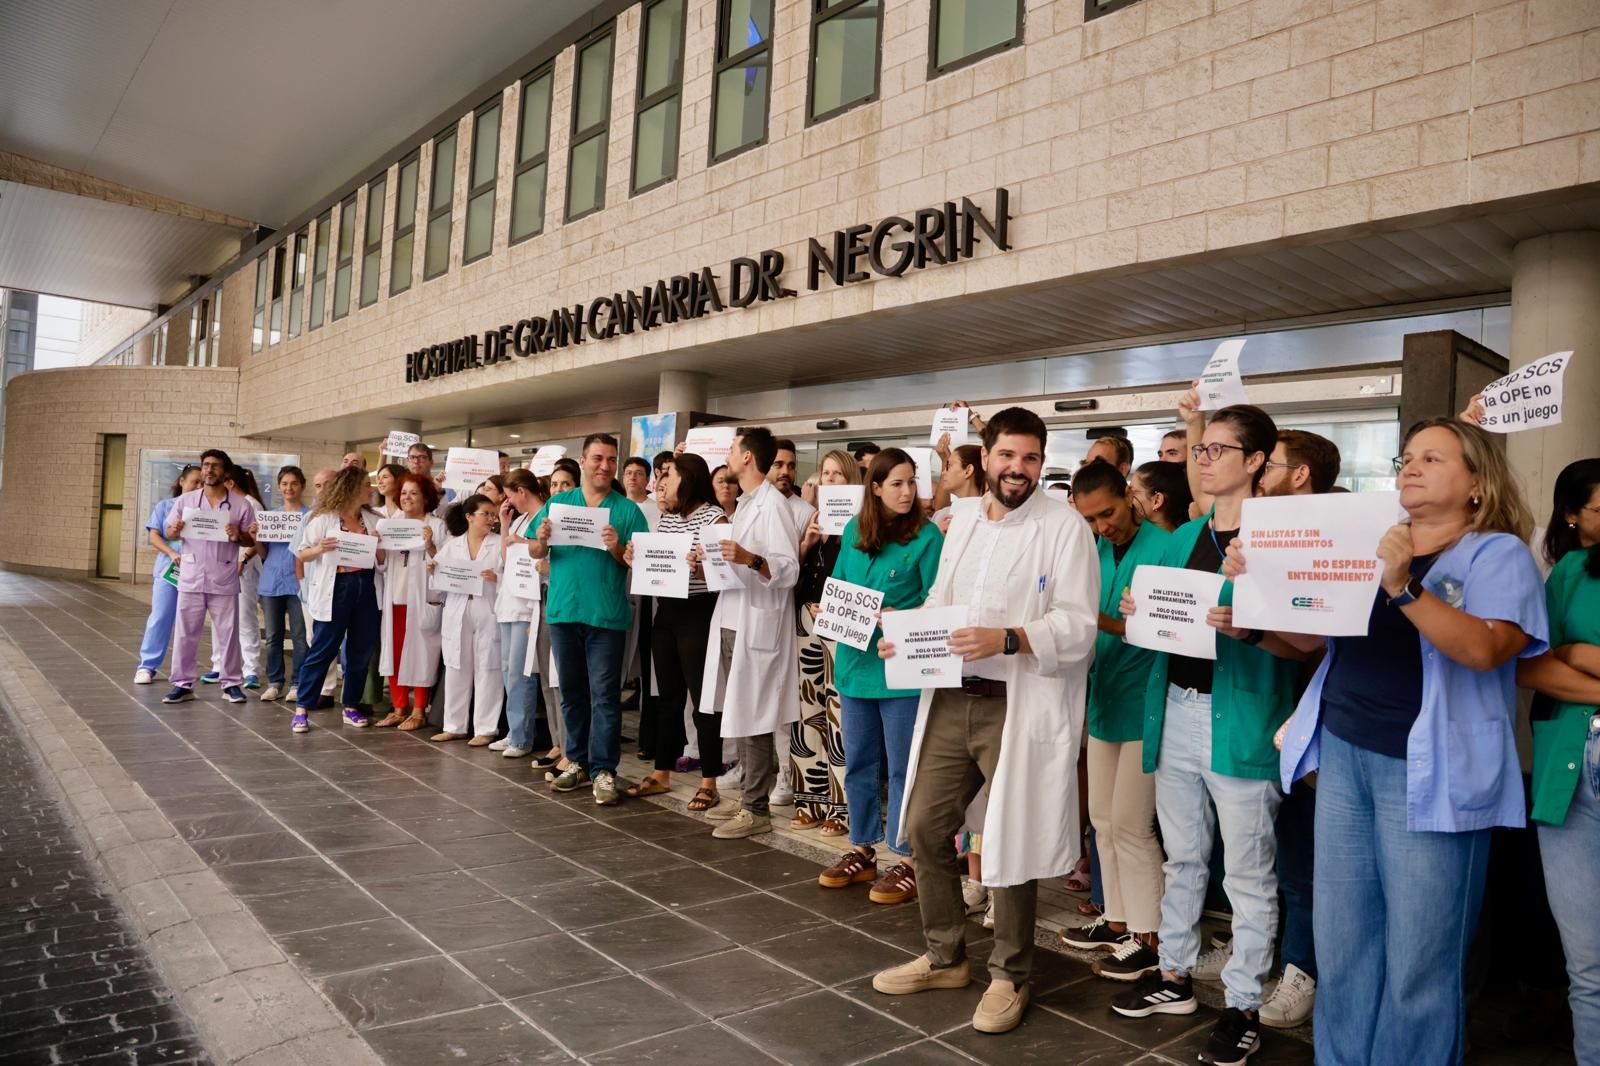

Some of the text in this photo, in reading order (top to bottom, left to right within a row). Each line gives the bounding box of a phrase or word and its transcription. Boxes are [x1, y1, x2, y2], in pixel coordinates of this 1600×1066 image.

[406, 334, 483, 383] HOSPITAL
[484, 325, 513, 365] DE
[513, 304, 584, 357] GRAN
[587, 266, 724, 340] CANARIA
[807, 187, 1010, 291] NEGRIN
[1523, 358, 1563, 379] SCS
[1484, 385, 1551, 407] la OPE no
[1480, 404, 1558, 425] es un juego
[264, 483, 271, 493] 2
[258, 513, 302, 523] Stop SCS
[1251, 529, 1320, 539] SIN LISTAS Y SIN
[1251, 540, 1333, 548] NOMBRAMIENTOS
[1312, 560, 1377, 569] NO ESPERES
[1287, 571, 1374, 582] ENTENDIMIENTO
[825, 583, 879, 610] Stop SCS
[1162, 589, 1180, 597] LISTAS
[1148, 594, 1197, 605] NOMBRAMIENTOS
[826, 602, 871, 626] la OPE no
[1149, 612, 1194, 624] ENFRENTAMIENTO
[818, 618, 868, 643] es un juego
